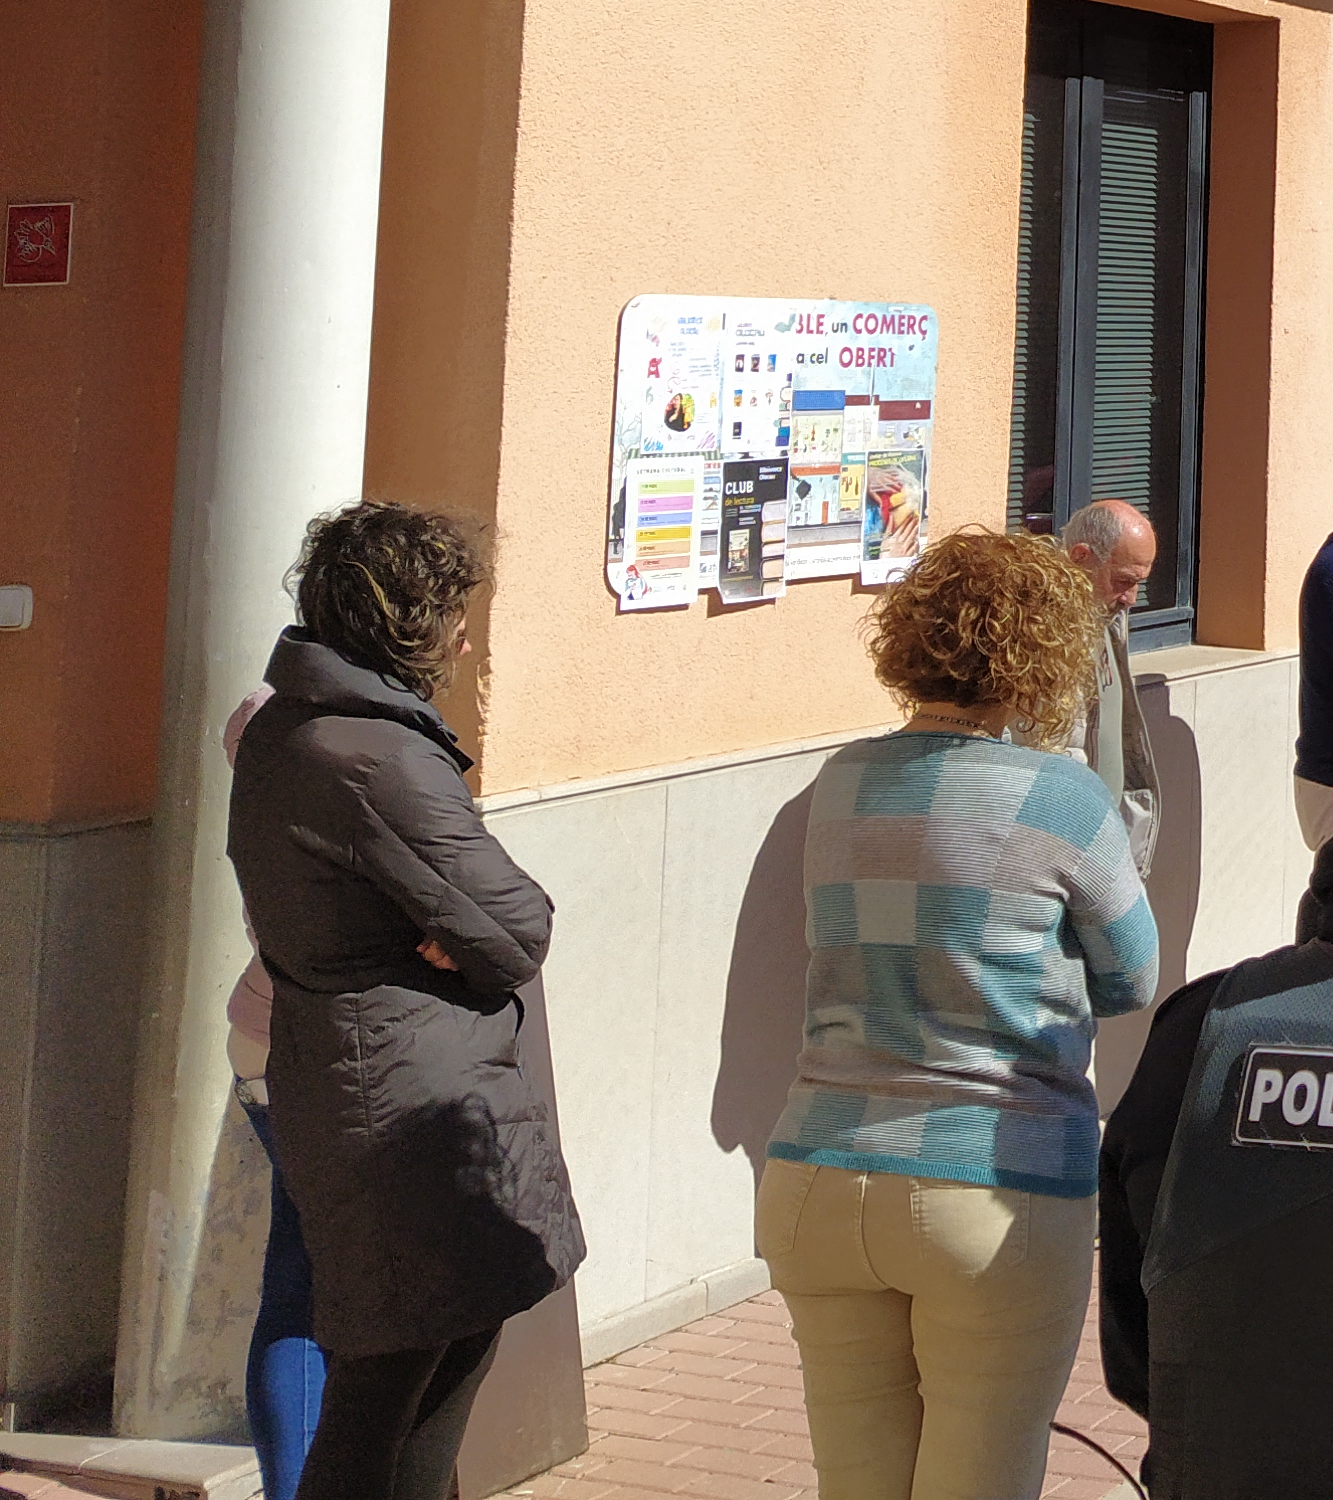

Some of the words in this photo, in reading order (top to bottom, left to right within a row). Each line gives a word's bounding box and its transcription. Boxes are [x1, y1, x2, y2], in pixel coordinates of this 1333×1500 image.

[832, 322, 848, 333] un
[853, 313, 929, 341] COMERÇ
[796, 353, 804, 364] a
[810, 347, 829, 364] cel
[839, 347, 896, 368] OBERT
[725, 480, 755, 495] CLUB
[725, 497, 733, 506] de
